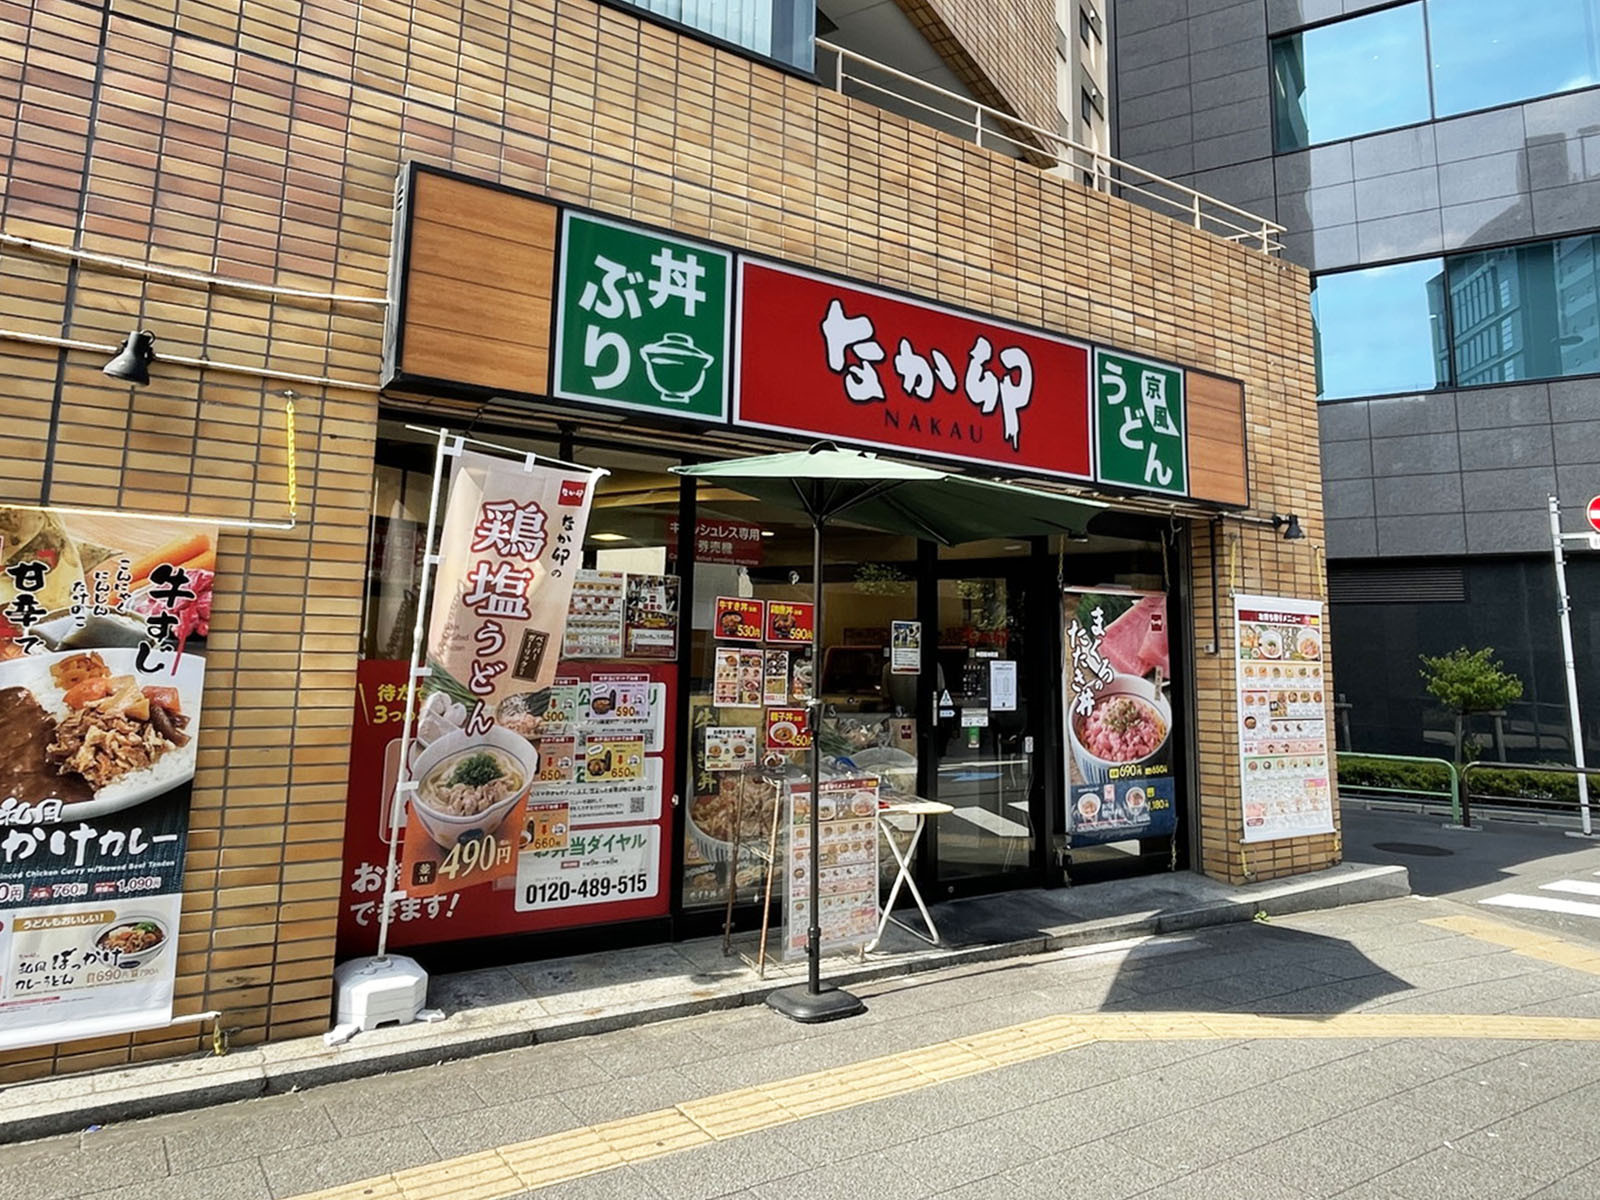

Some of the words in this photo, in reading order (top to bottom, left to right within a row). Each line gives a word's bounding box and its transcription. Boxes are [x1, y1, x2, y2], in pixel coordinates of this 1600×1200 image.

[821, 299, 1034, 452] なか卯
[1101, 361, 1173, 486] うどん
[1145, 375, 1170, 430] 京風
[884, 409, 984, 443] NAKAU
[551, 514, 575, 578] なか卯の
[670, 522, 760, 541] キシュレス専用
[71, 581, 89, 627] たけのこ
[93, 571, 110, 616] にんじん
[115, 559, 131, 612] こんにゃく
[136, 565, 195, 674] 牛すじ
[463, 500, 548, 737] 鶏塩うどん
[1067, 619, 1096, 717] たたき丼
[1, 822, 178, 866] かけカレー
[438, 835, 511, 880] 490円
[26, 868, 58, 878] Chicken
[61, 867, 85, 876] Curry
[51, 883, 88, 898] 760円
[526, 874, 647, 904] 0120-489-515
[22, 913, 105, 929] うどんもおいしい!
